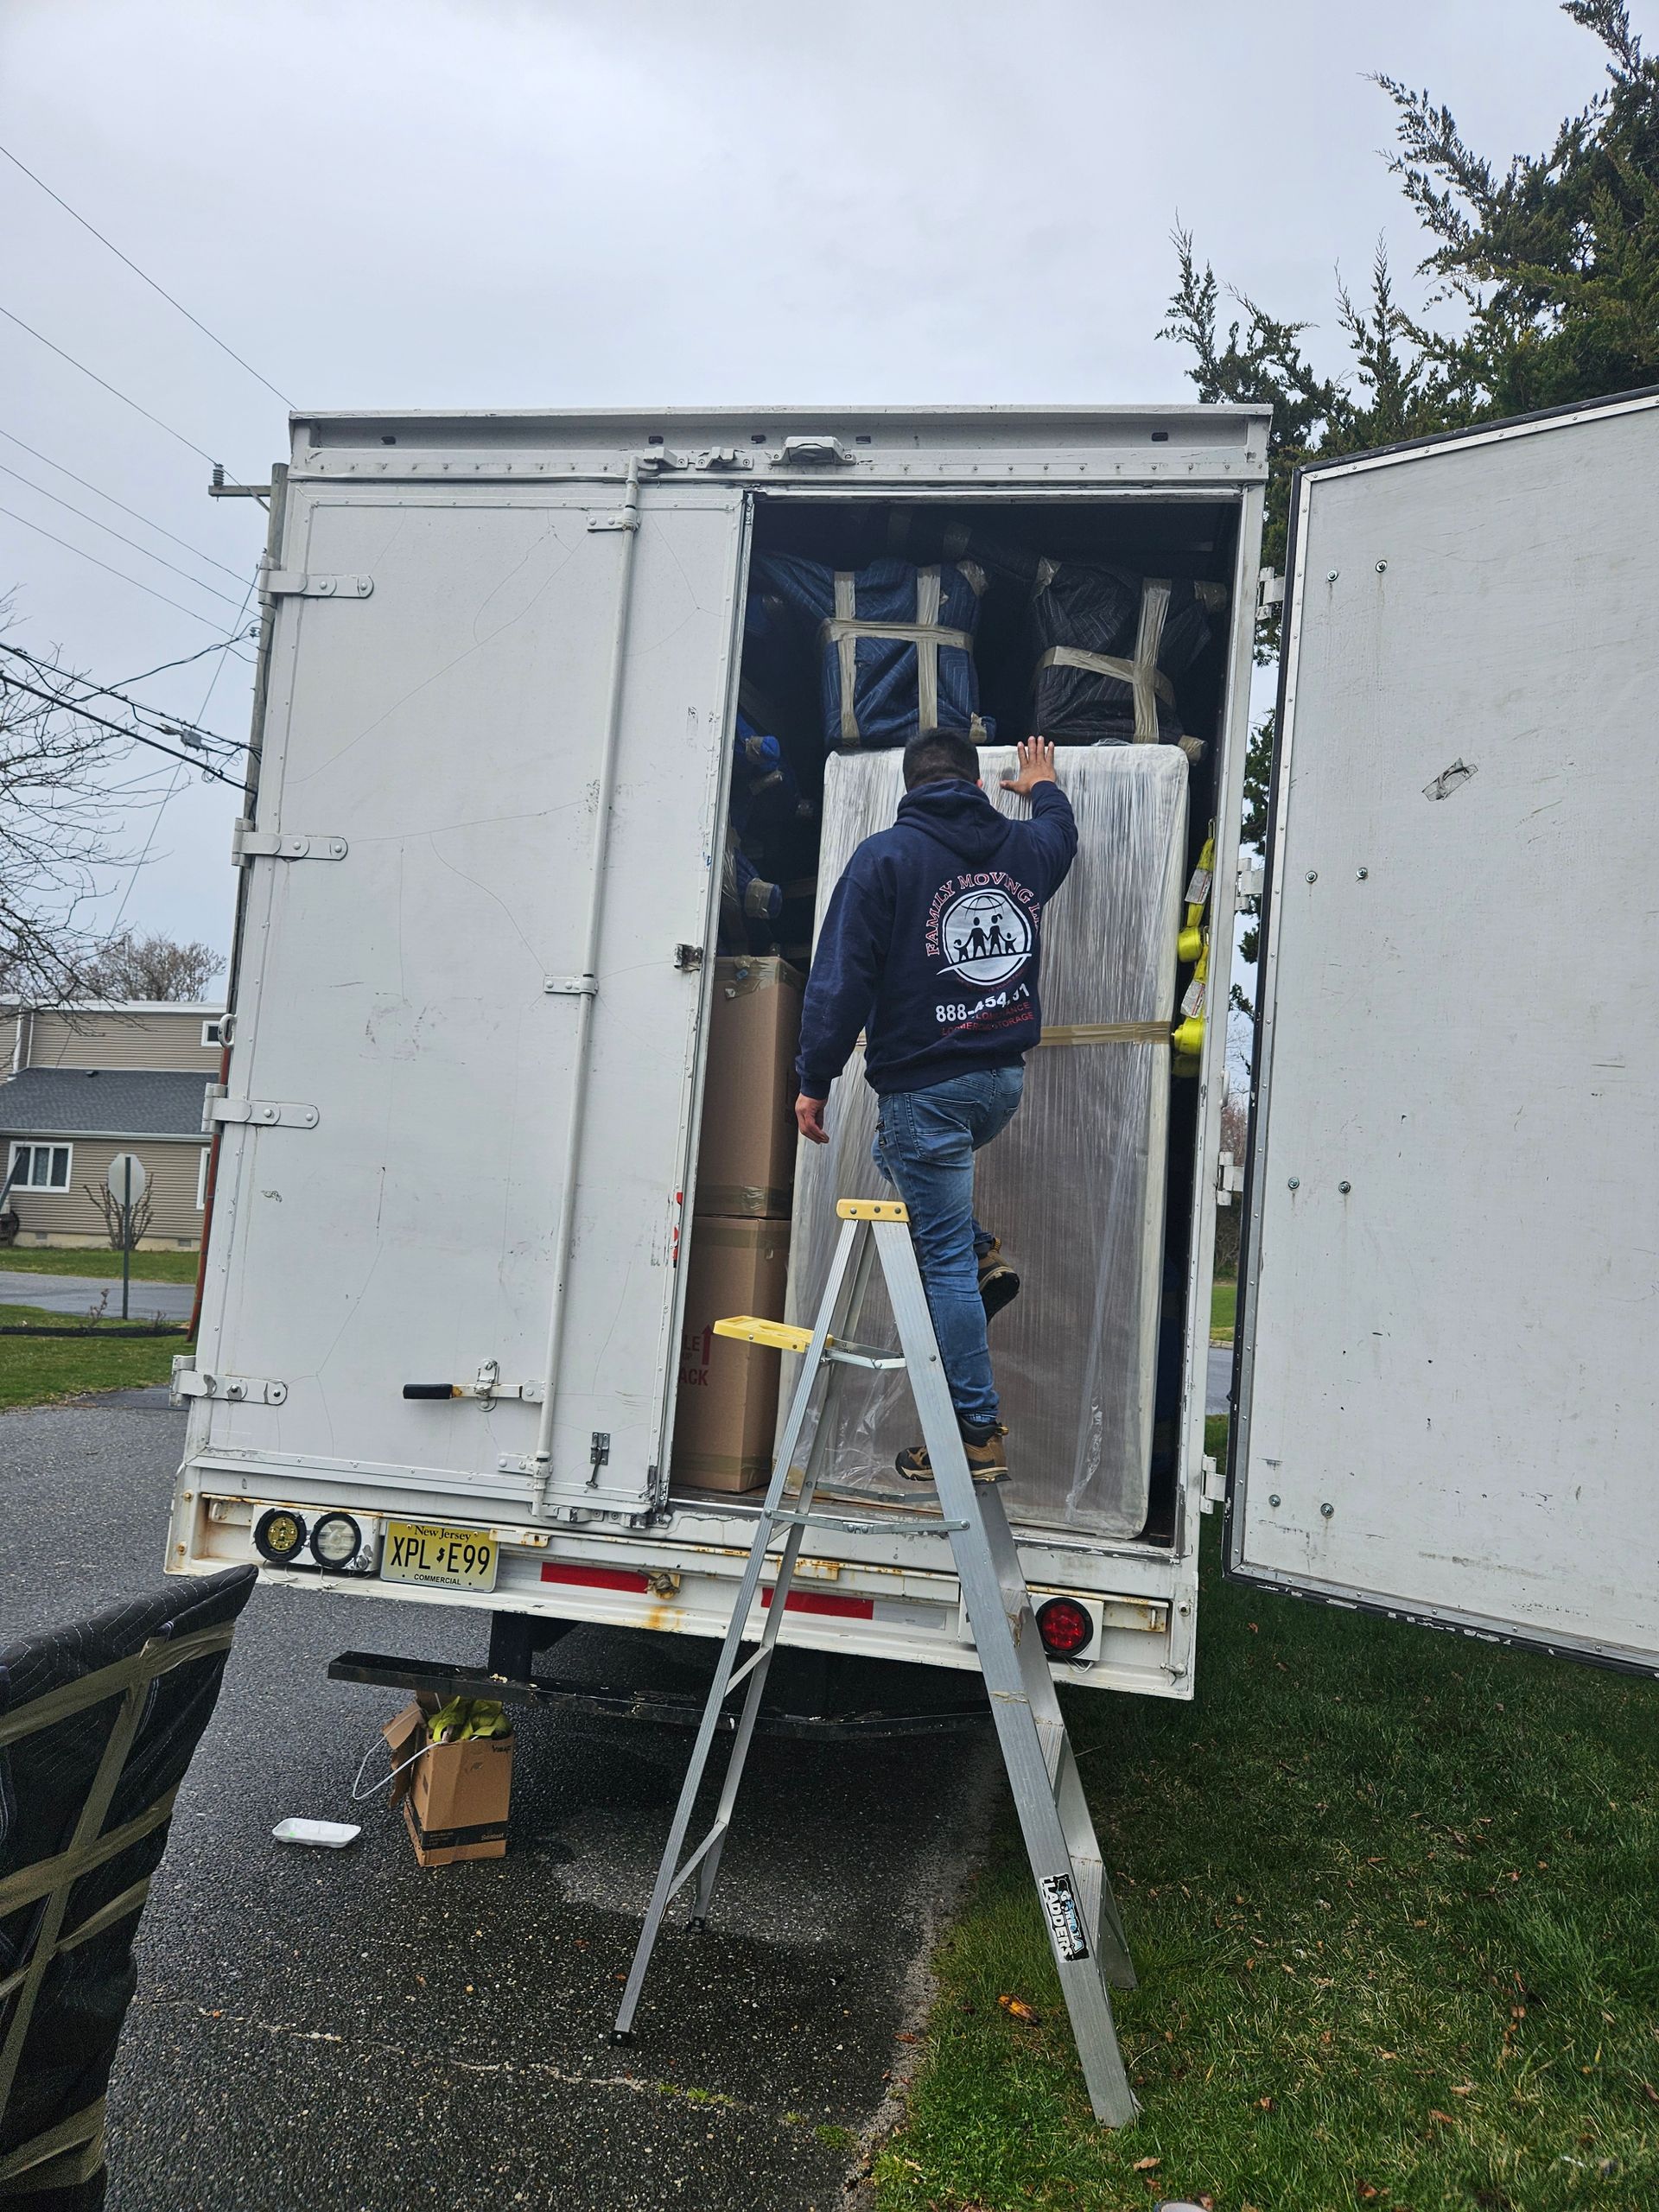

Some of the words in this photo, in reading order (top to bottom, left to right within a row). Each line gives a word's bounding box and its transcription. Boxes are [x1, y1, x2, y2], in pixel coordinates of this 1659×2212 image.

[925, 880, 957, 957] FAMILY
[415, 1525, 437, 1537] New
[439, 1528, 472, 1542] Jersey
[390, 1535, 431, 1570] XPL
[447, 1542, 491, 1575] E99
[414, 1573, 461, 1586] COMMERCIAL
[1043, 1882, 1073, 1956] LADDERS
